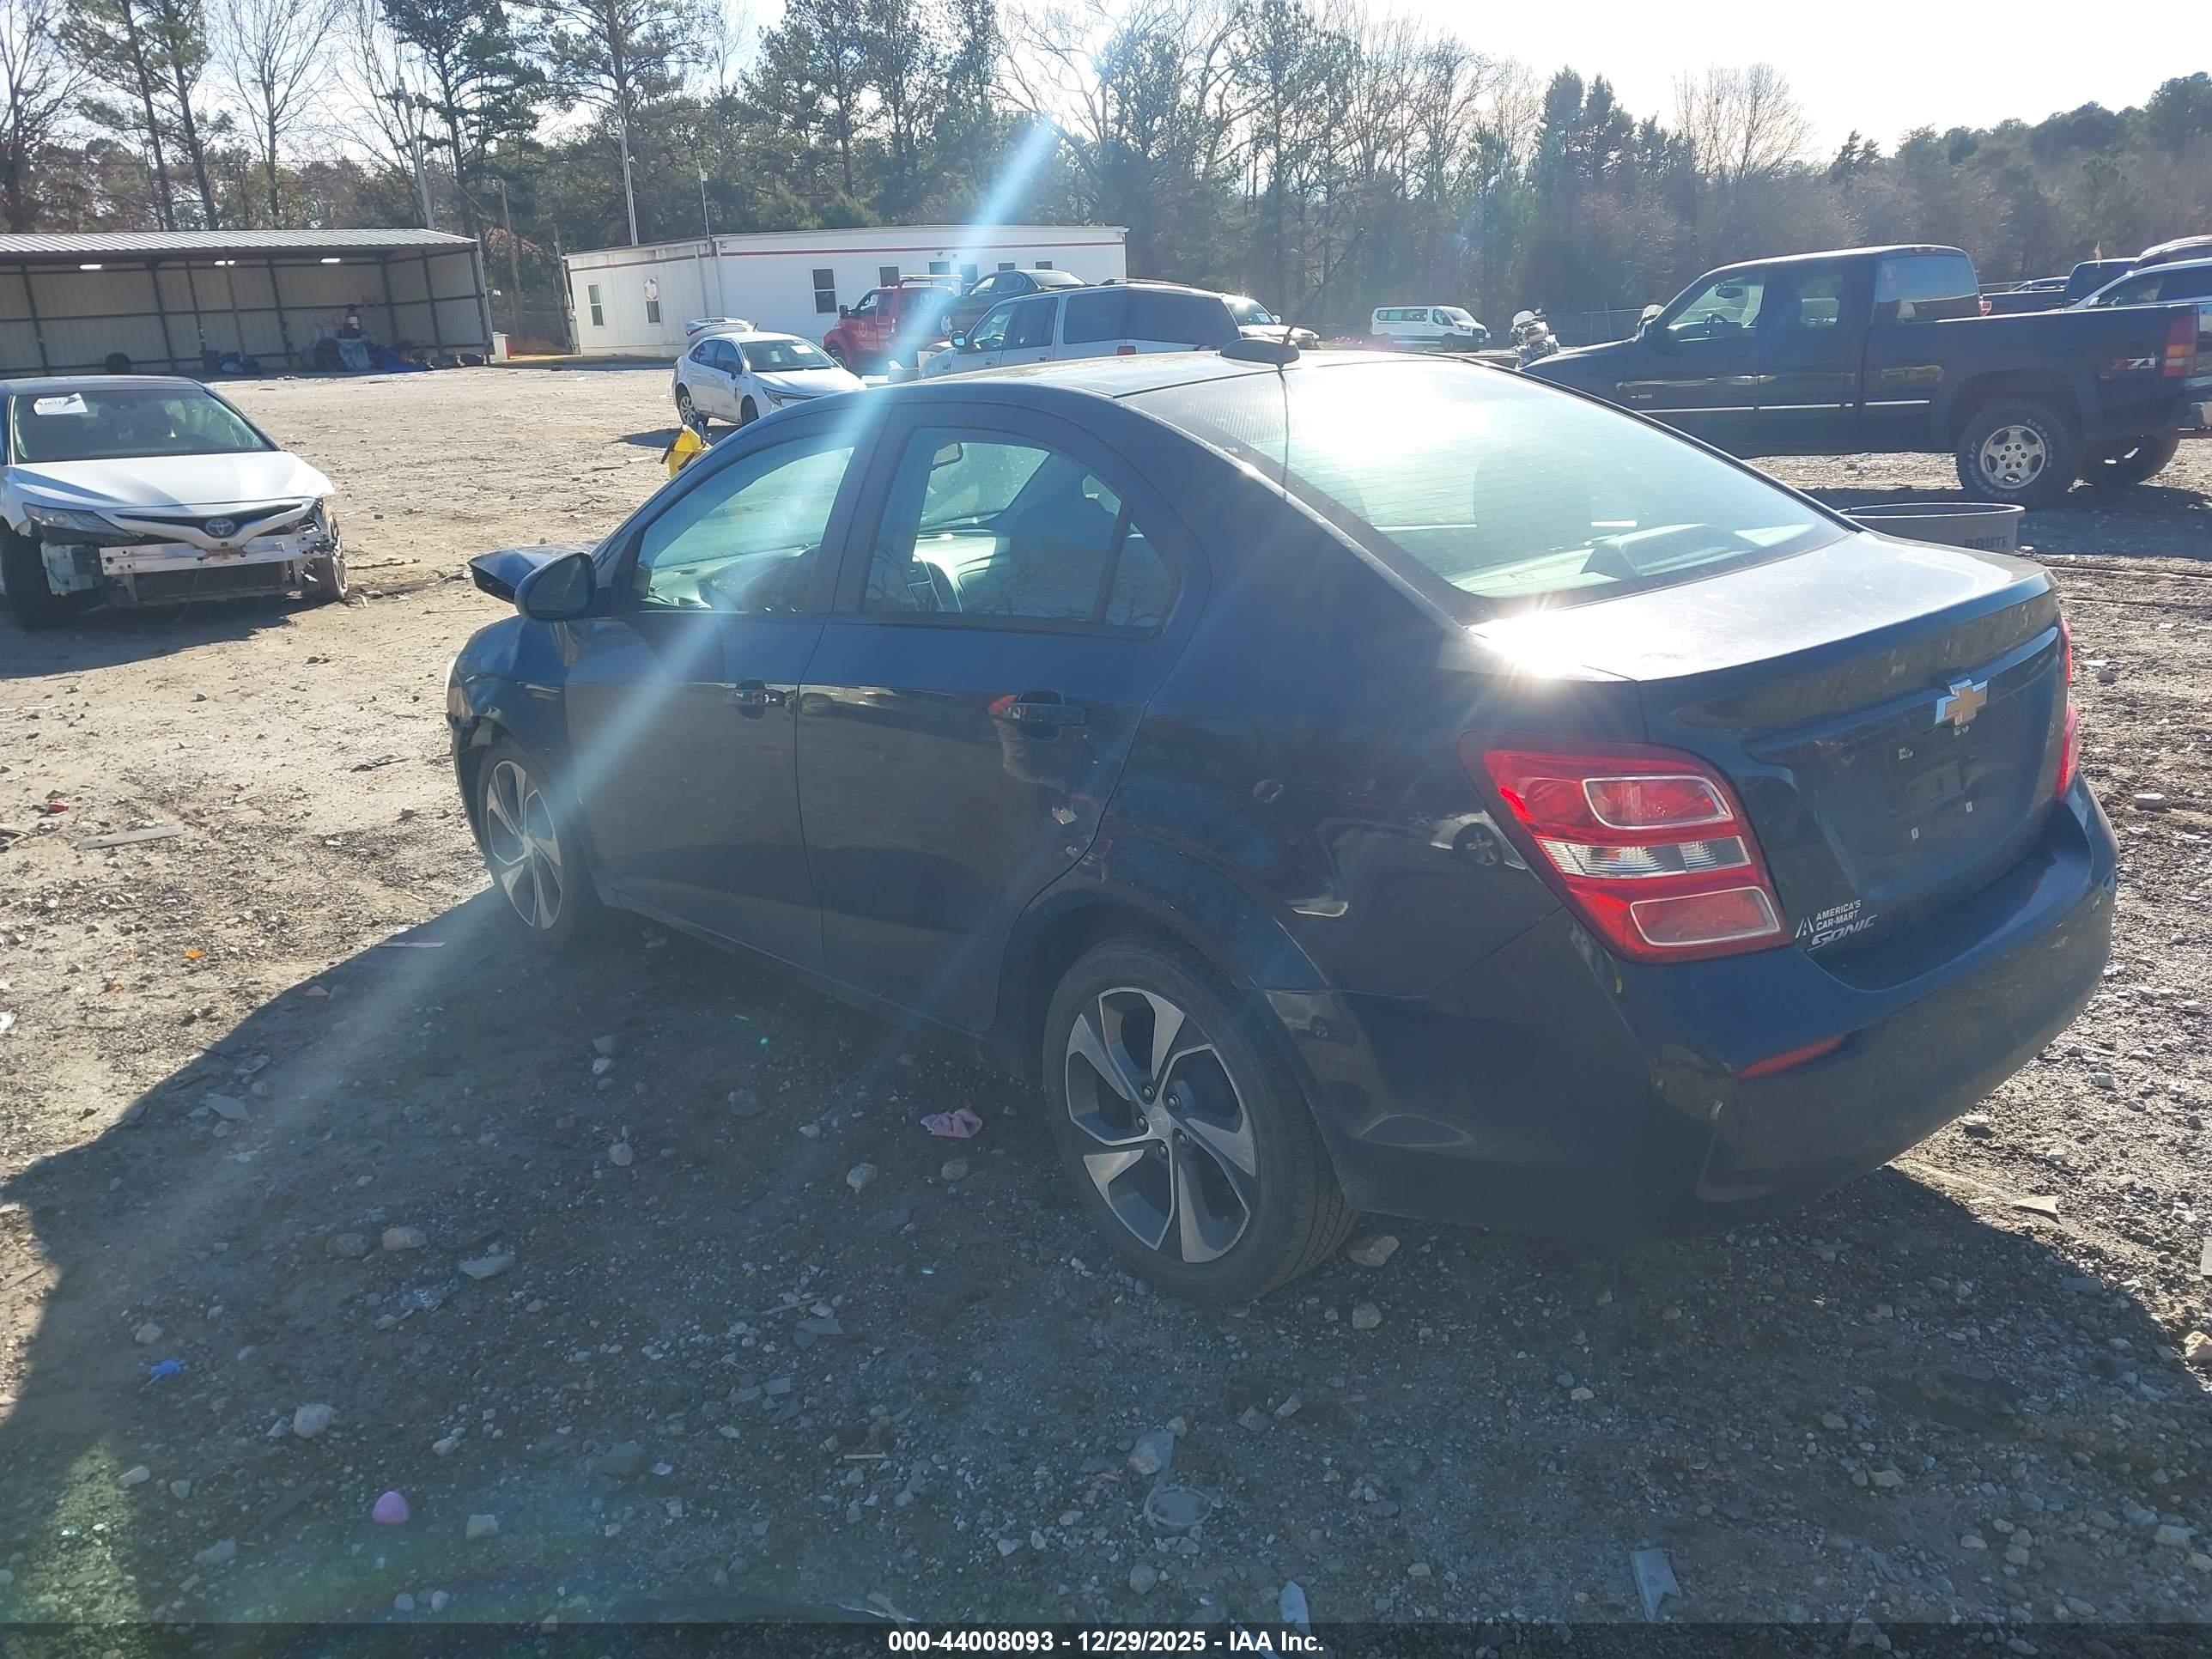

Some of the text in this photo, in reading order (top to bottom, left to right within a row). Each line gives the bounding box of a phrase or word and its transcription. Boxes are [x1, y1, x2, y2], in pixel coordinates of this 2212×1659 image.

[2111, 357, 2156, 369] Z71
[1964, 535, 2008, 550] BRUTE
[1816, 899, 1862, 922] AMERICA'S
[1816, 909, 1859, 931] CAR-MART
[1807, 914, 1878, 951] SONIC
